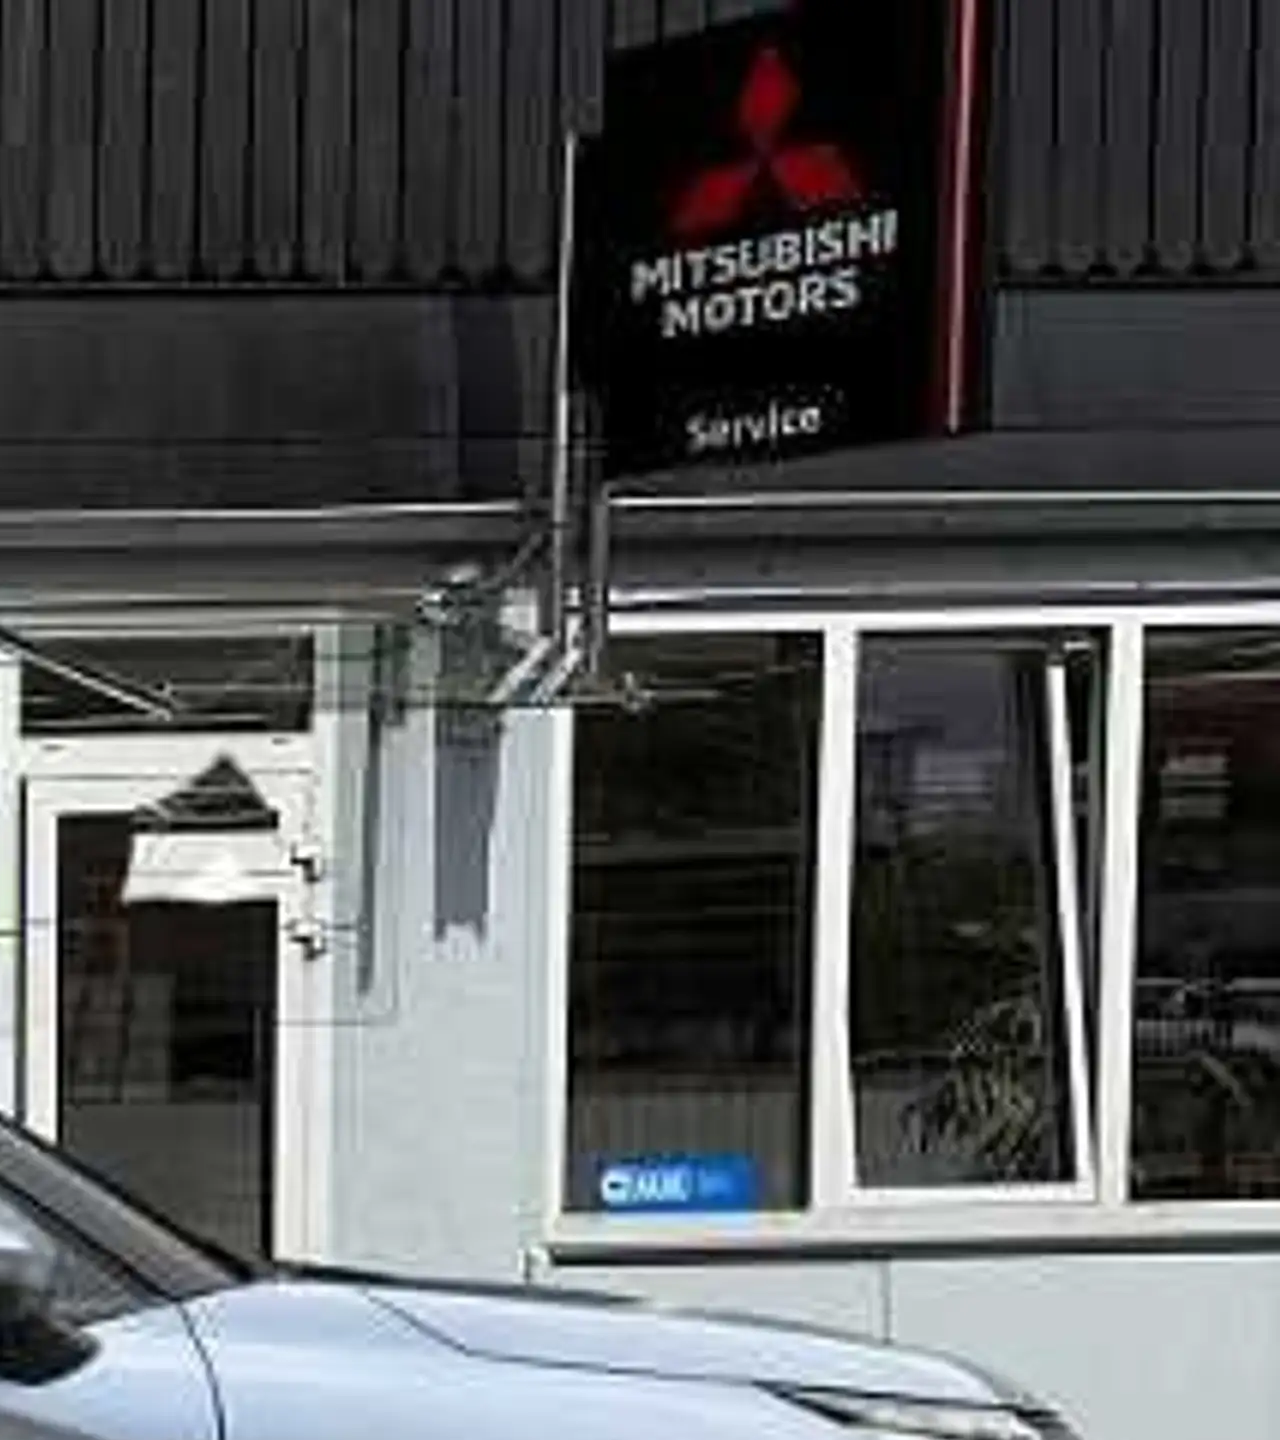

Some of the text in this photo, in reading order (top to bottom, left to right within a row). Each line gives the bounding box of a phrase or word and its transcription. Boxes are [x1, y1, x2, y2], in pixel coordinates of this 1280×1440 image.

[630, 209, 897, 300] MITSUBISHI
[662, 267, 860, 338] MOTORS
[686, 402, 821, 450] Service
